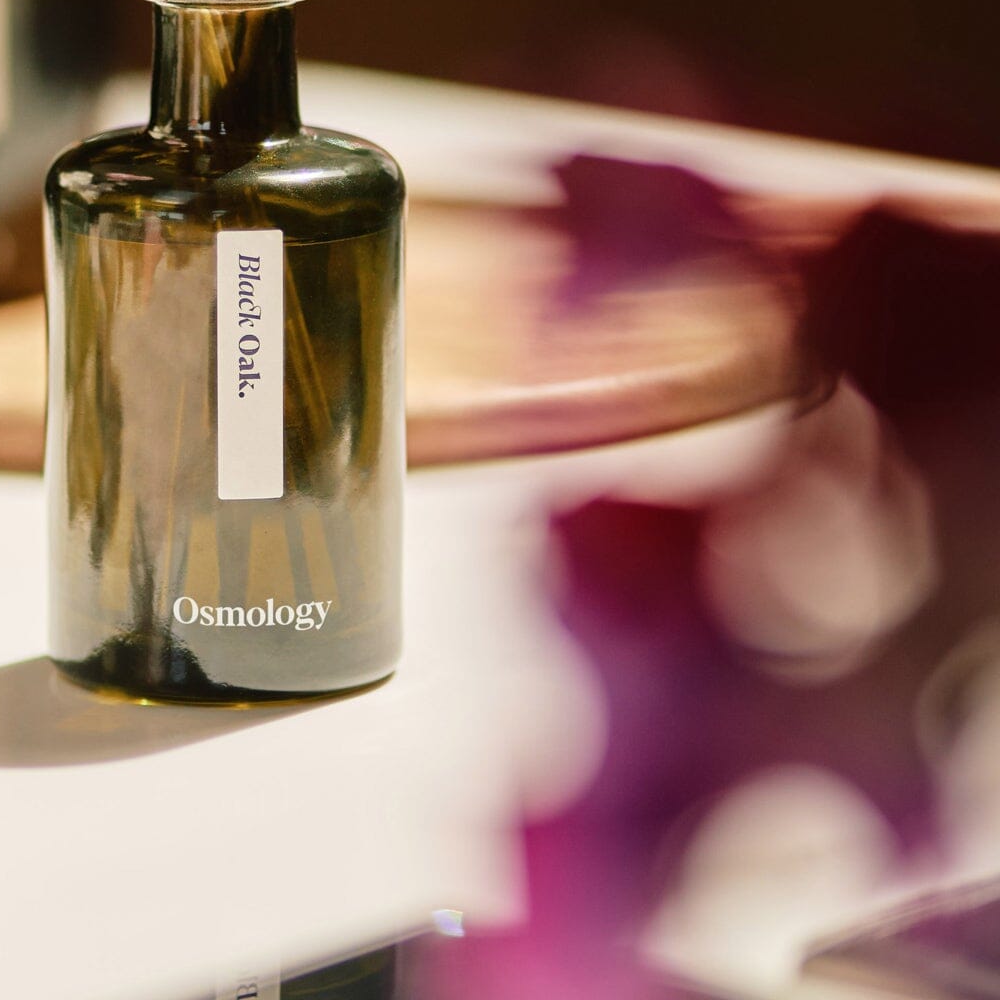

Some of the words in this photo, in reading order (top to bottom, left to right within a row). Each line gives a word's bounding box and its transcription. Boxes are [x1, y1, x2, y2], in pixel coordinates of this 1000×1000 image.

[238, 253, 261, 327] Black
[238, 334, 261, 398] Oak.
[173, 596, 333, 631] Osmology
